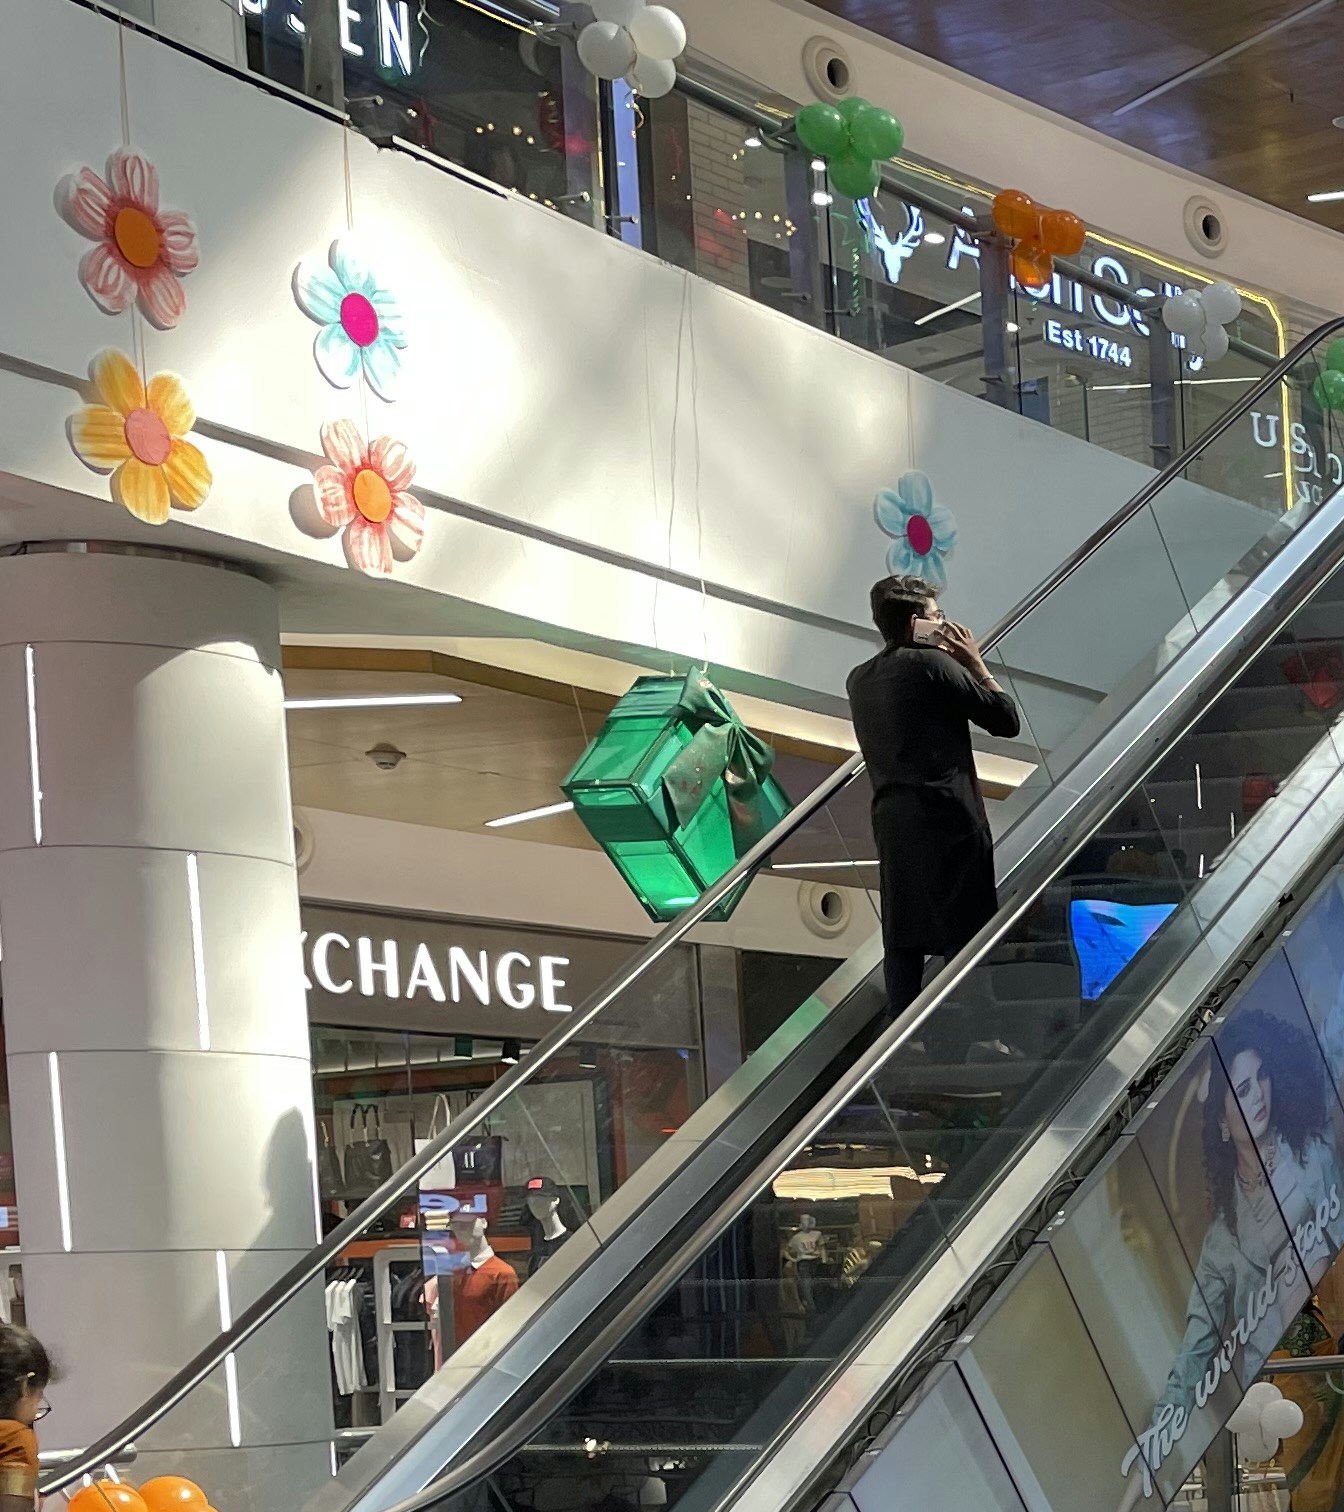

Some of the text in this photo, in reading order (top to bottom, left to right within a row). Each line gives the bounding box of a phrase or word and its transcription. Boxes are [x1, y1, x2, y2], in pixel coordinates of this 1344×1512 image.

[1043, 320, 1132, 368] Est 1744
[1121, 1404, 1189, 1498] The
